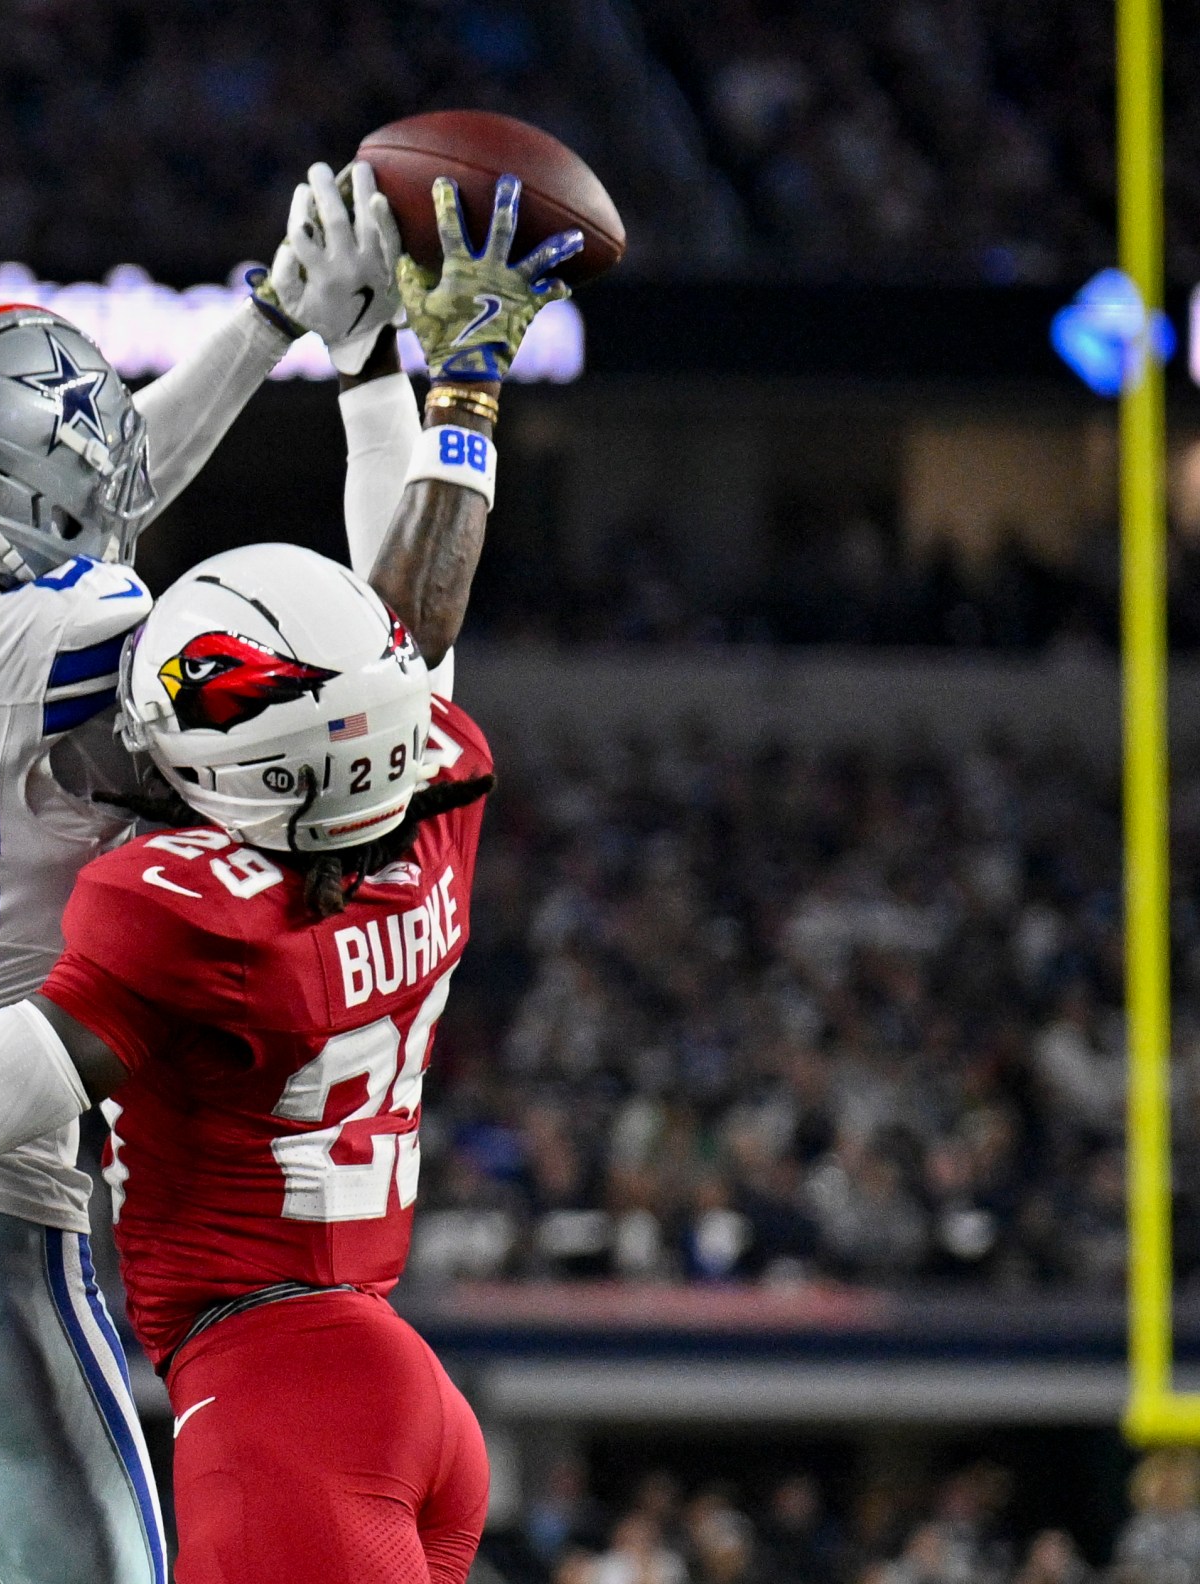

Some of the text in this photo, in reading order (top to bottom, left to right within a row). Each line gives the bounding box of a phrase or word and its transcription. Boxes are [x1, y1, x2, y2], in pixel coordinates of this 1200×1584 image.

[439, 429, 487, 473] 88
[266, 770, 289, 789] 40
[350, 743, 407, 795] 29
[143, 829, 284, 899] 29
[334, 864, 462, 1009] BURKE
